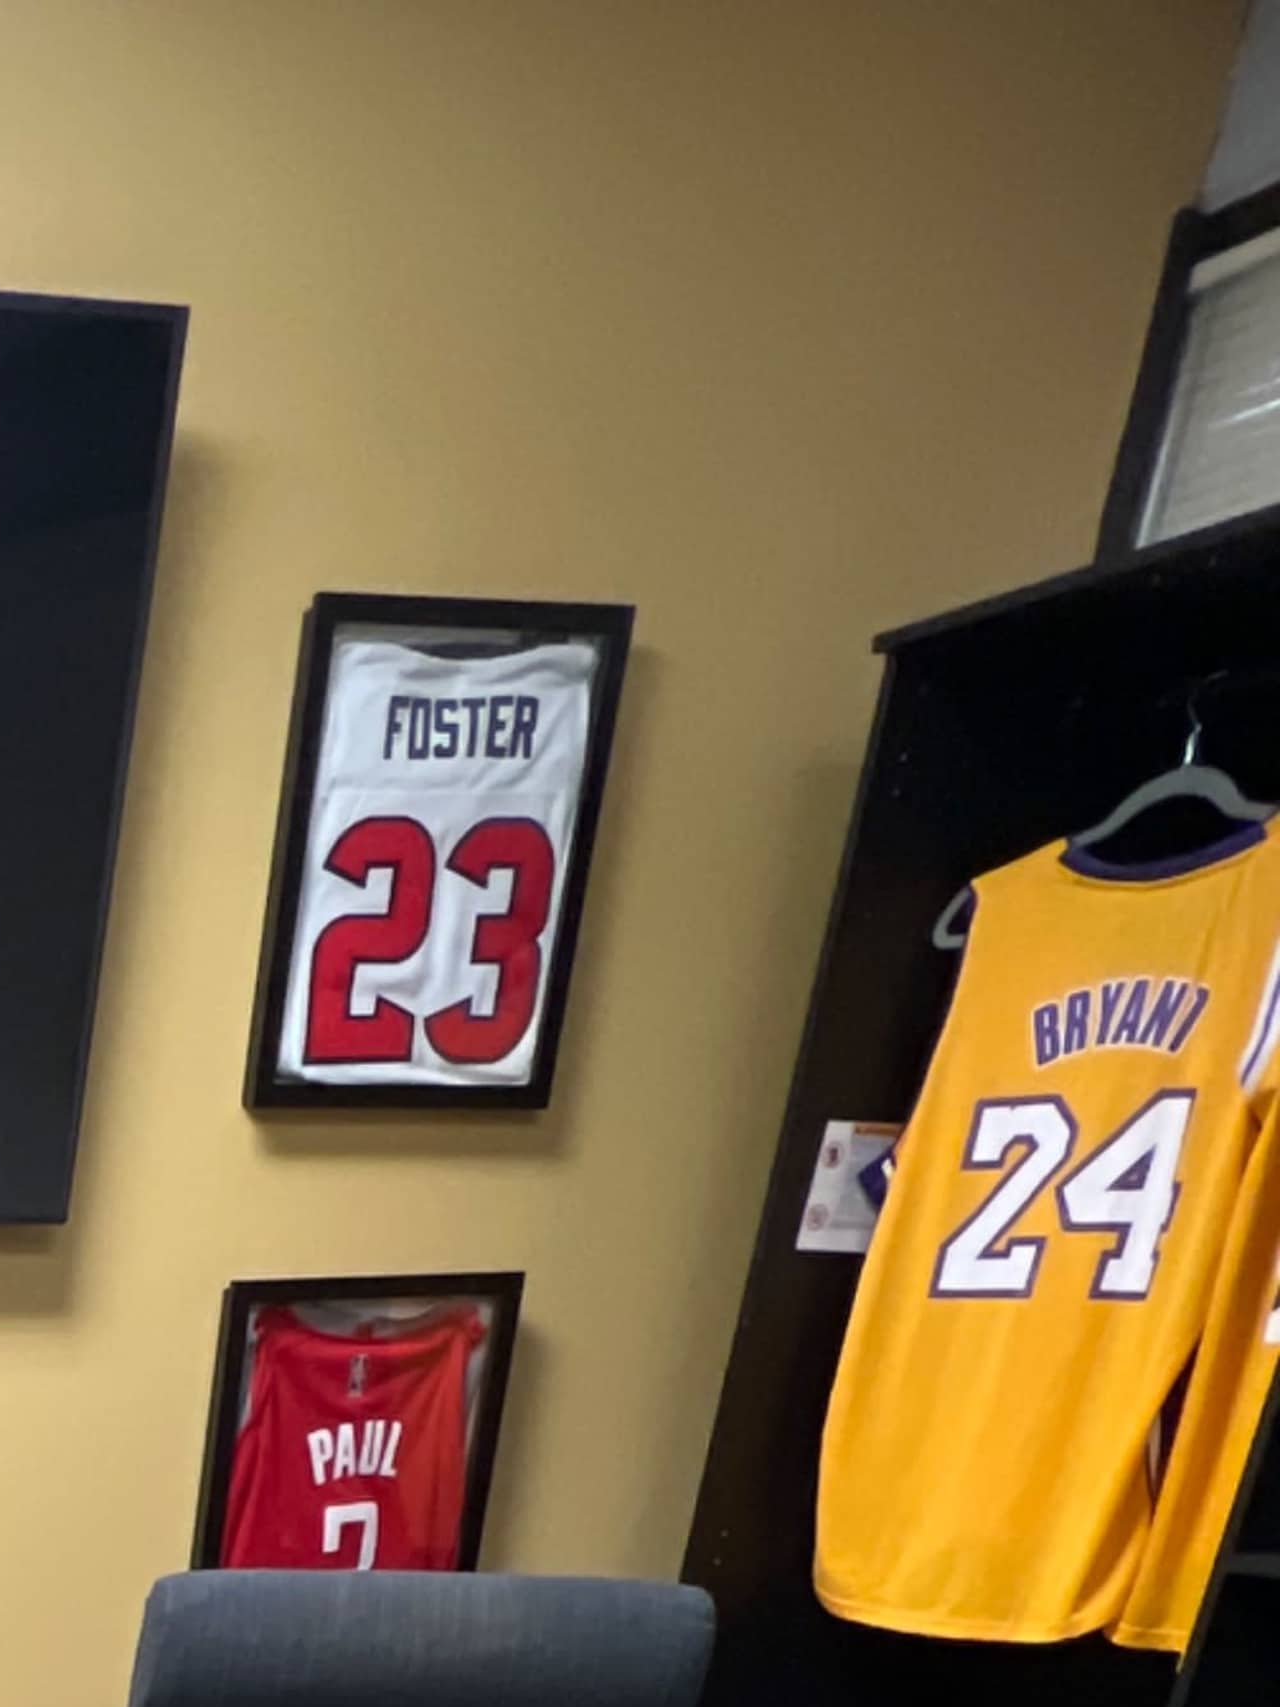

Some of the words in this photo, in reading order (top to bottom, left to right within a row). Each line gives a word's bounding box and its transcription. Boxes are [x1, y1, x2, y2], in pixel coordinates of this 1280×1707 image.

[382, 695, 540, 760] FOSTER
[302, 815, 555, 1067] 23
[929, 1087, 1197, 1301] 24
[306, 1419, 403, 1486] PAUL
